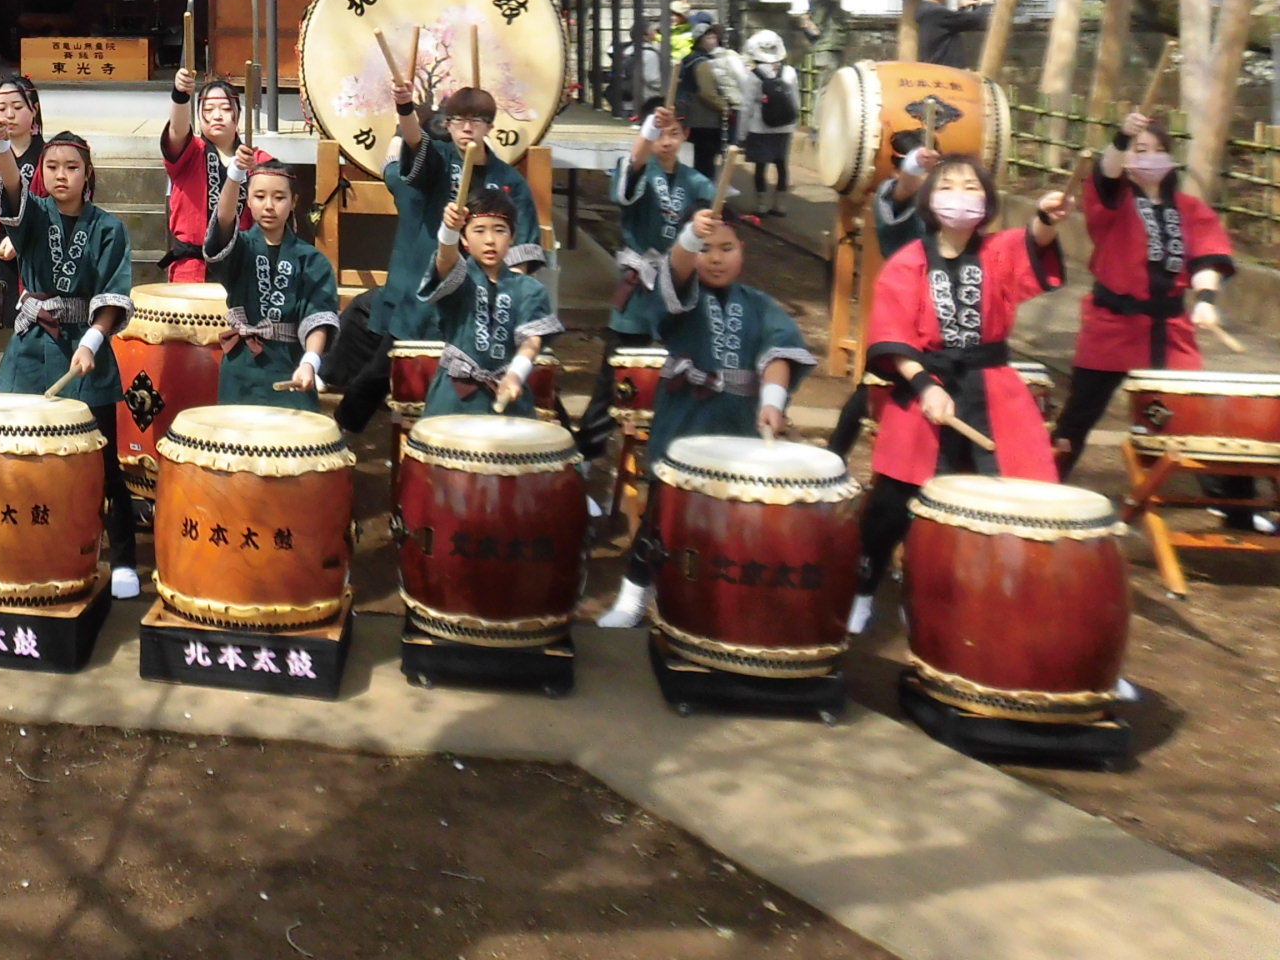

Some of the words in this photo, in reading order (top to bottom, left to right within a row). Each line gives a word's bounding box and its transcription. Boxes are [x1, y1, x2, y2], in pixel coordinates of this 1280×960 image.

[52, 62, 116, 75] 東光寺
[181, 517, 294, 551] 北本太鼓
[184, 640, 318, 680] 北本太鼓
